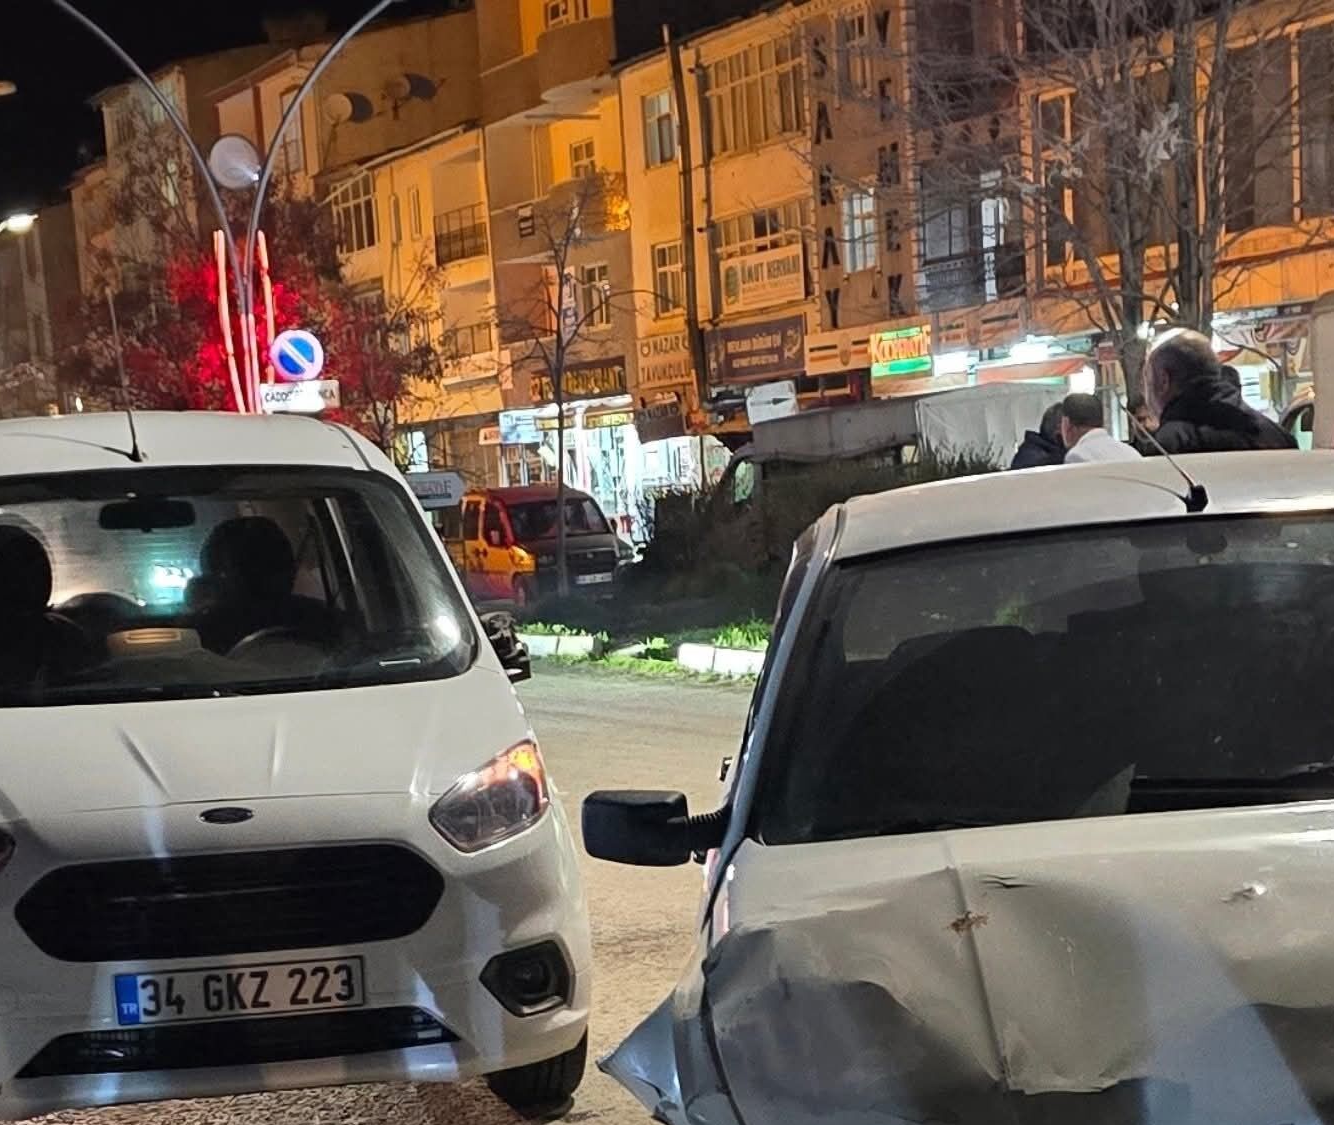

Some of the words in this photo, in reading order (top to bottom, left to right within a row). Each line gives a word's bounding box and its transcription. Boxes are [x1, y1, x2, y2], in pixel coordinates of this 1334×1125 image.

[141, 977, 186, 1018] 34
[202, 970, 272, 1014] GKZ
[287, 963, 355, 1006] 223
